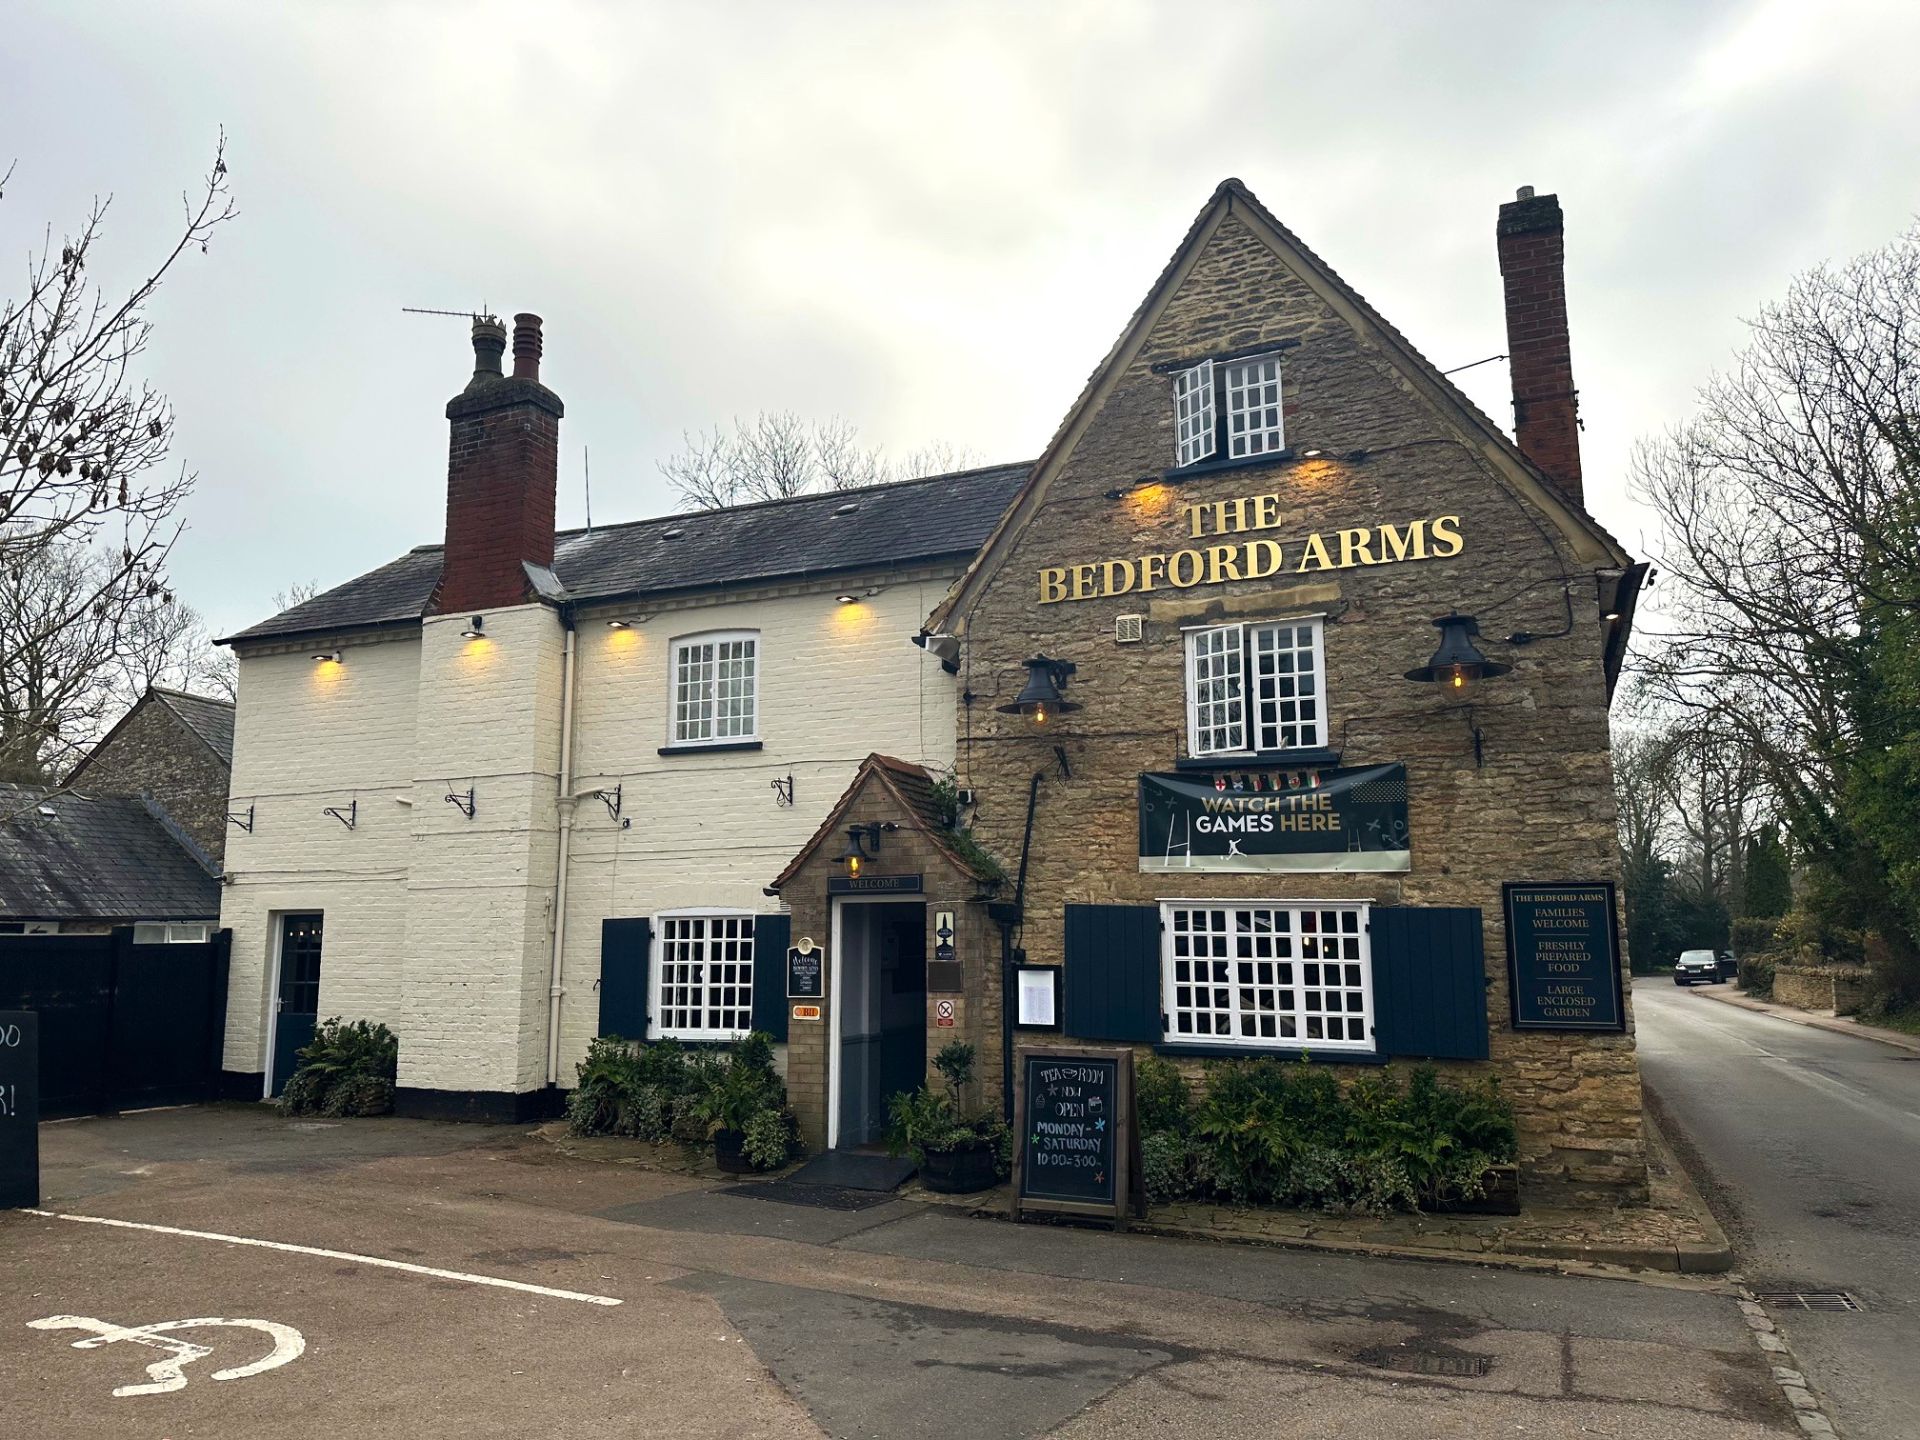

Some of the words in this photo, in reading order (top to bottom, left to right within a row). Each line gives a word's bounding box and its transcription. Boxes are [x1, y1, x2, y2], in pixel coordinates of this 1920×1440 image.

[1182, 493, 1282, 539] THE
[1037, 539, 1283, 605] BEDFORD
[1296, 515, 1464, 574] ARMS
[1202, 796, 1281, 814] WATCH
[1283, 793, 1333, 811] THE
[1196, 814, 1274, 833] GAMES
[1280, 813, 1341, 832] HERE
[849, 879, 901, 889] WELCOME
[1534, 894, 1577, 902] BEDFORD
[1578, 894, 1604, 902] ARMS
[1535, 908, 1585, 917] FAMILIES
[1532, 919, 1589, 929] WELCOME
[1538, 941, 1586, 951] FRESHLY
[1535, 952, 1591, 962] PREPARED
[1548, 963, 1580, 973] FOOD
[1547, 985, 1584, 995] LARGE
[1537, 996, 1596, 1007] ENCLOSED
[1543, 1007, 1590, 1018] GARDEN
[1040, 1068, 1061, 1083] TEA
[1078, 1067, 1104, 1085] ROOM
[1061, 1086, 1082, 1097] NOW
[1055, 1102, 1084, 1117] OPEN
[1043, 1137, 1102, 1153] SATURDAY
